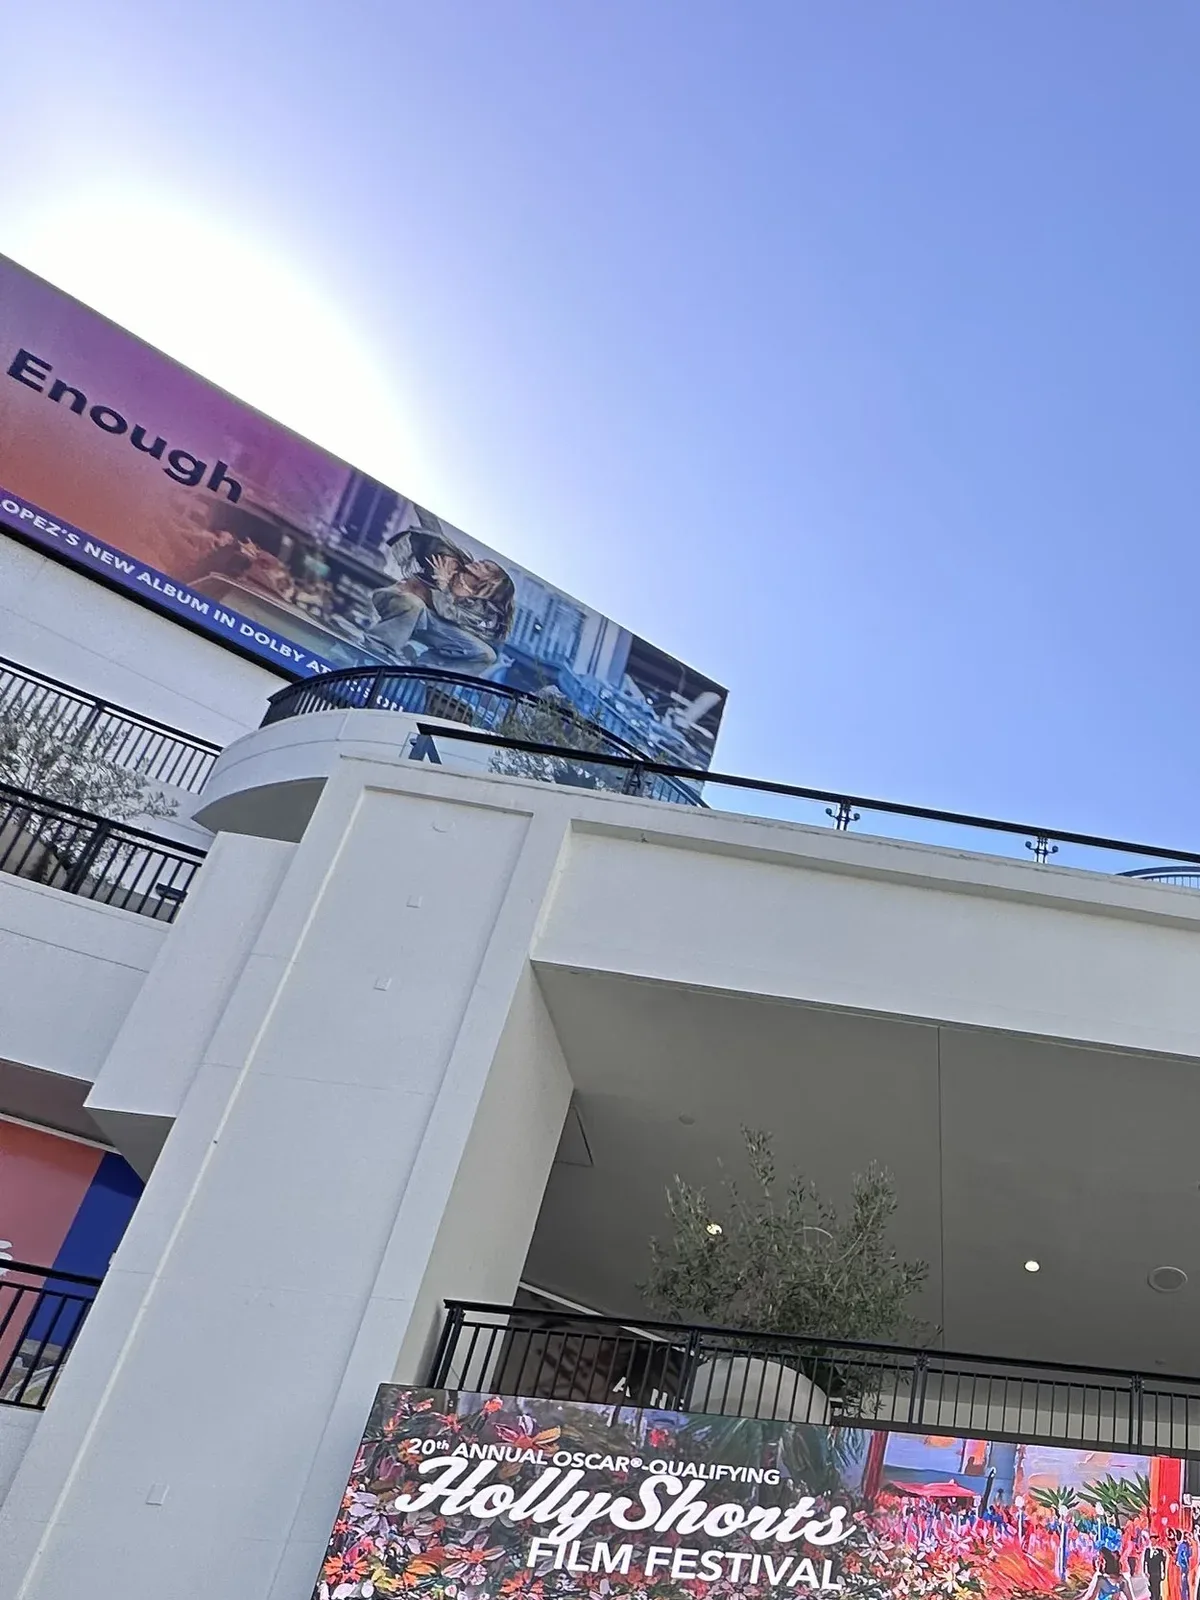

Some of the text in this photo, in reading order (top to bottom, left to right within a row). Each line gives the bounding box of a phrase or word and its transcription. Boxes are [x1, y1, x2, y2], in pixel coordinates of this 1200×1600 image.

[6, 348, 244, 504] Enough
[0, 499, 80, 546] OPEZ'S
[84, 541, 135, 574] NEW
[136, 571, 209, 615] ALBUM
[213, 609, 236, 628] IN
[239, 624, 305, 662] DOLBY
[408, 1437, 449, 1455] 20th
[451, 1442, 548, 1465] ANNUAL
[395, 1456, 856, 1546] HollyShorts
[526, 1536, 843, 1590] FILM FESTIVAL
